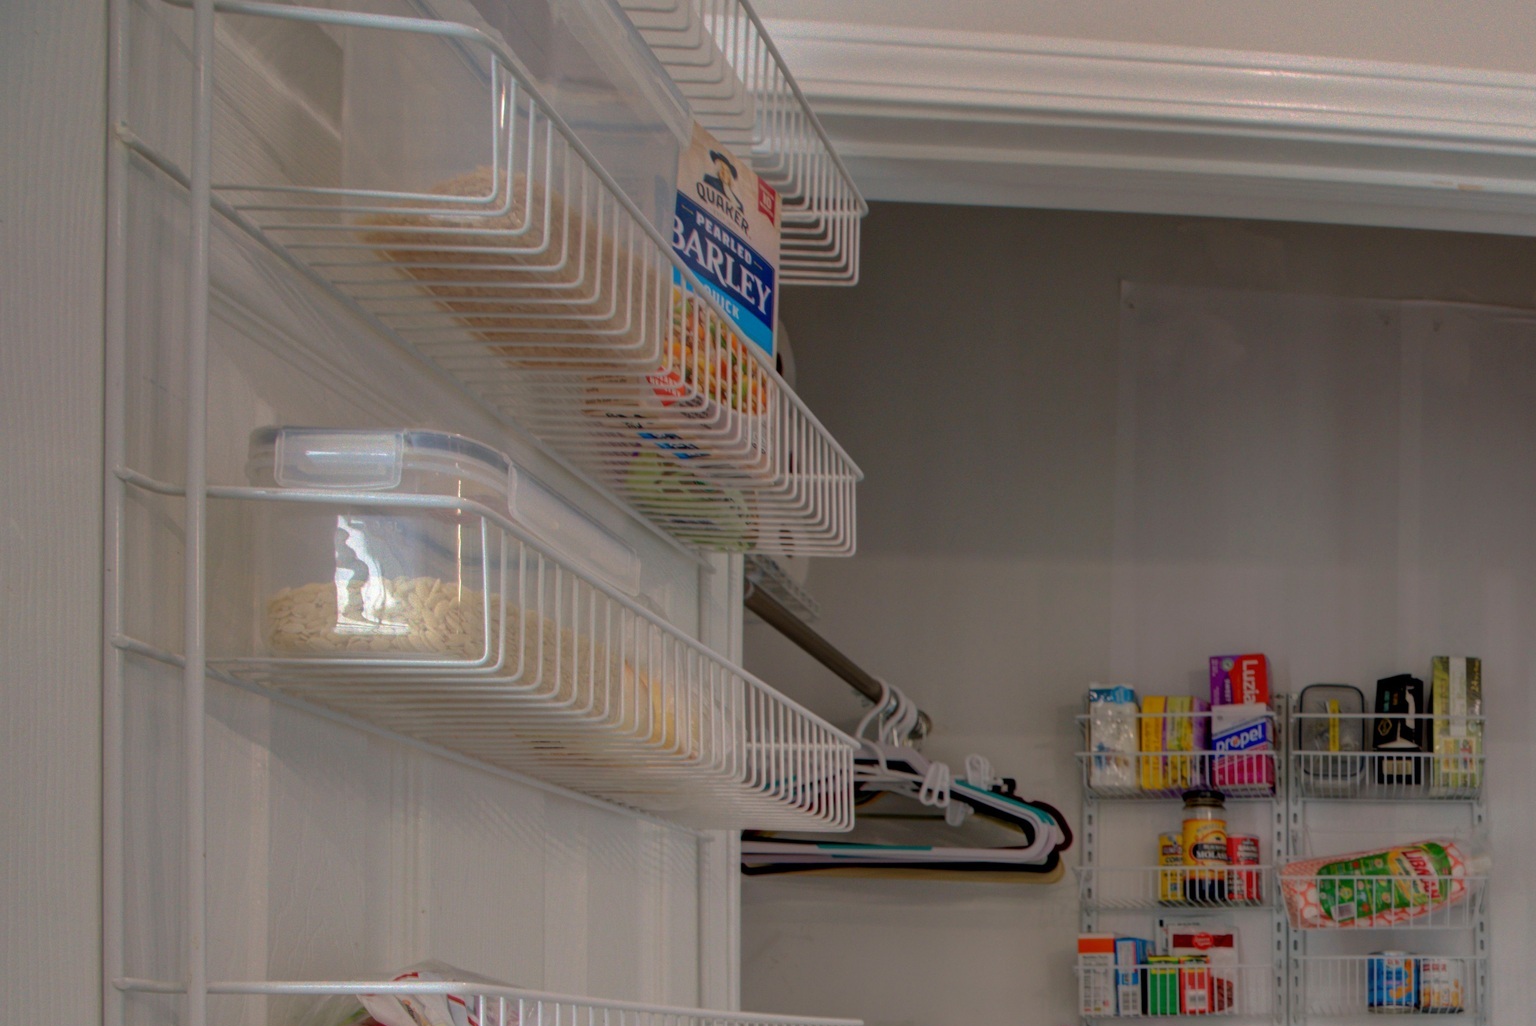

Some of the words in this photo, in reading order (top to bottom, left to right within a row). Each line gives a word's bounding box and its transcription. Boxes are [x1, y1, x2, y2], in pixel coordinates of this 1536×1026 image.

[696, 182, 751, 235] QUAKER
[695, 210, 753, 266] PEARLED
[673, 215, 772, 316] BARLEY
[703, 284, 740, 320] QUICK
[1215, 723, 1264, 757] propel
